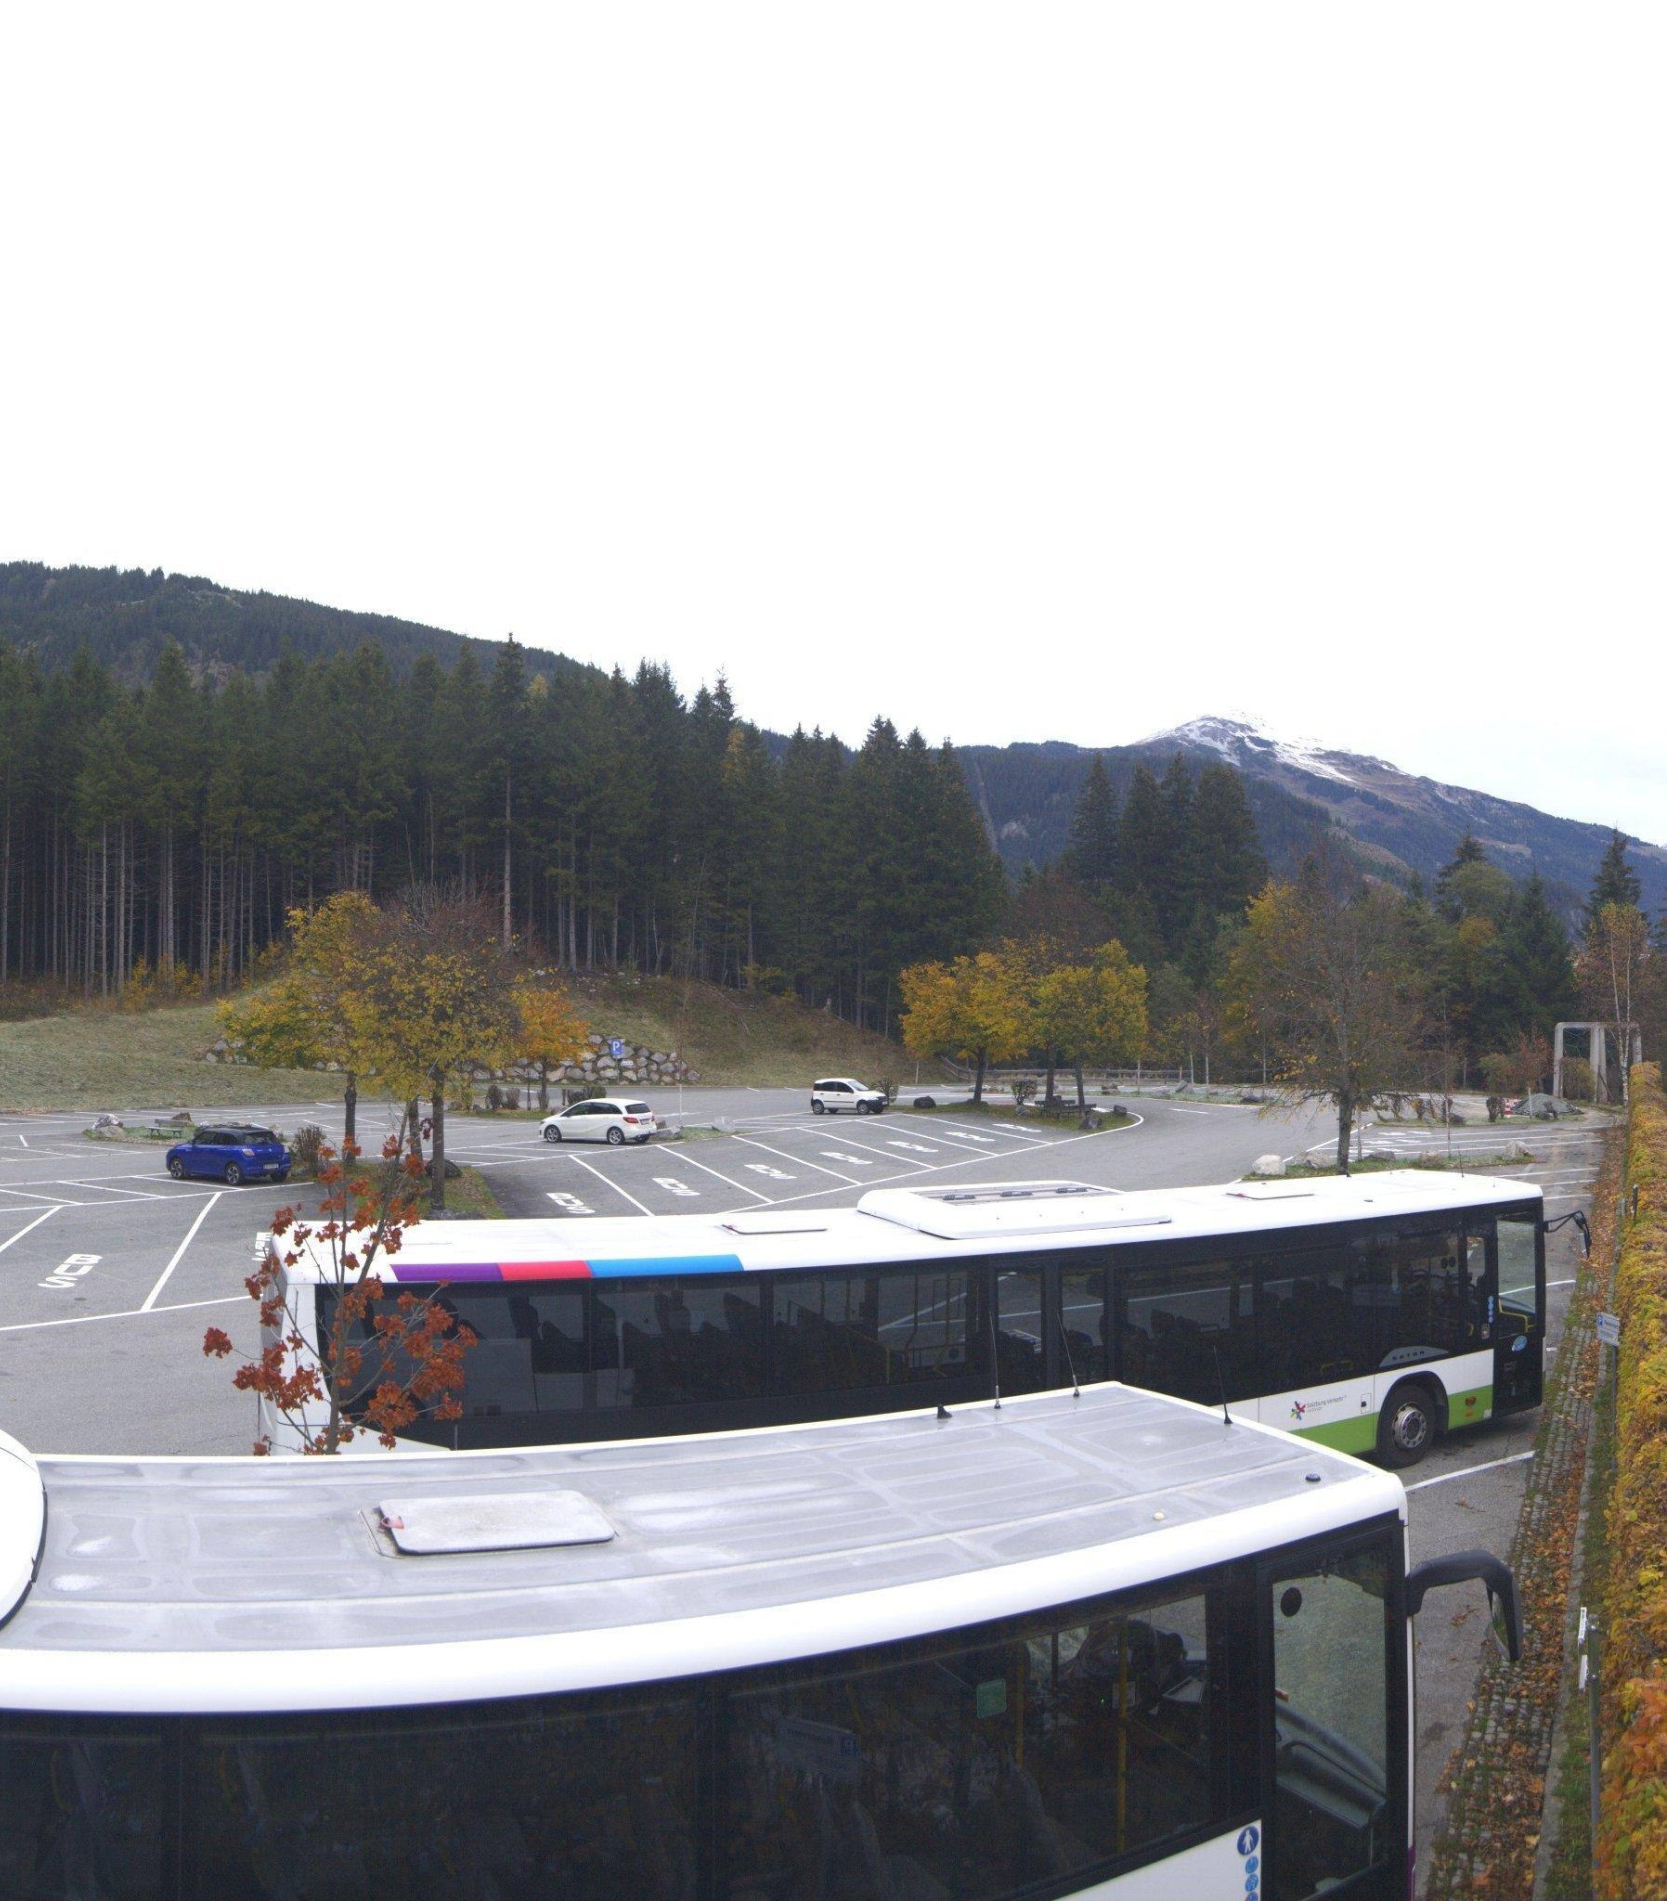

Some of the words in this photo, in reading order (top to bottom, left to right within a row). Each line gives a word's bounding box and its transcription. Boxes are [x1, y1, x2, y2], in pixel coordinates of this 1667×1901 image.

[652, 1177, 701, 1197] BUS
[546, 1192, 596, 1214] BUS
[37, 1253, 103, 1289] BUS
